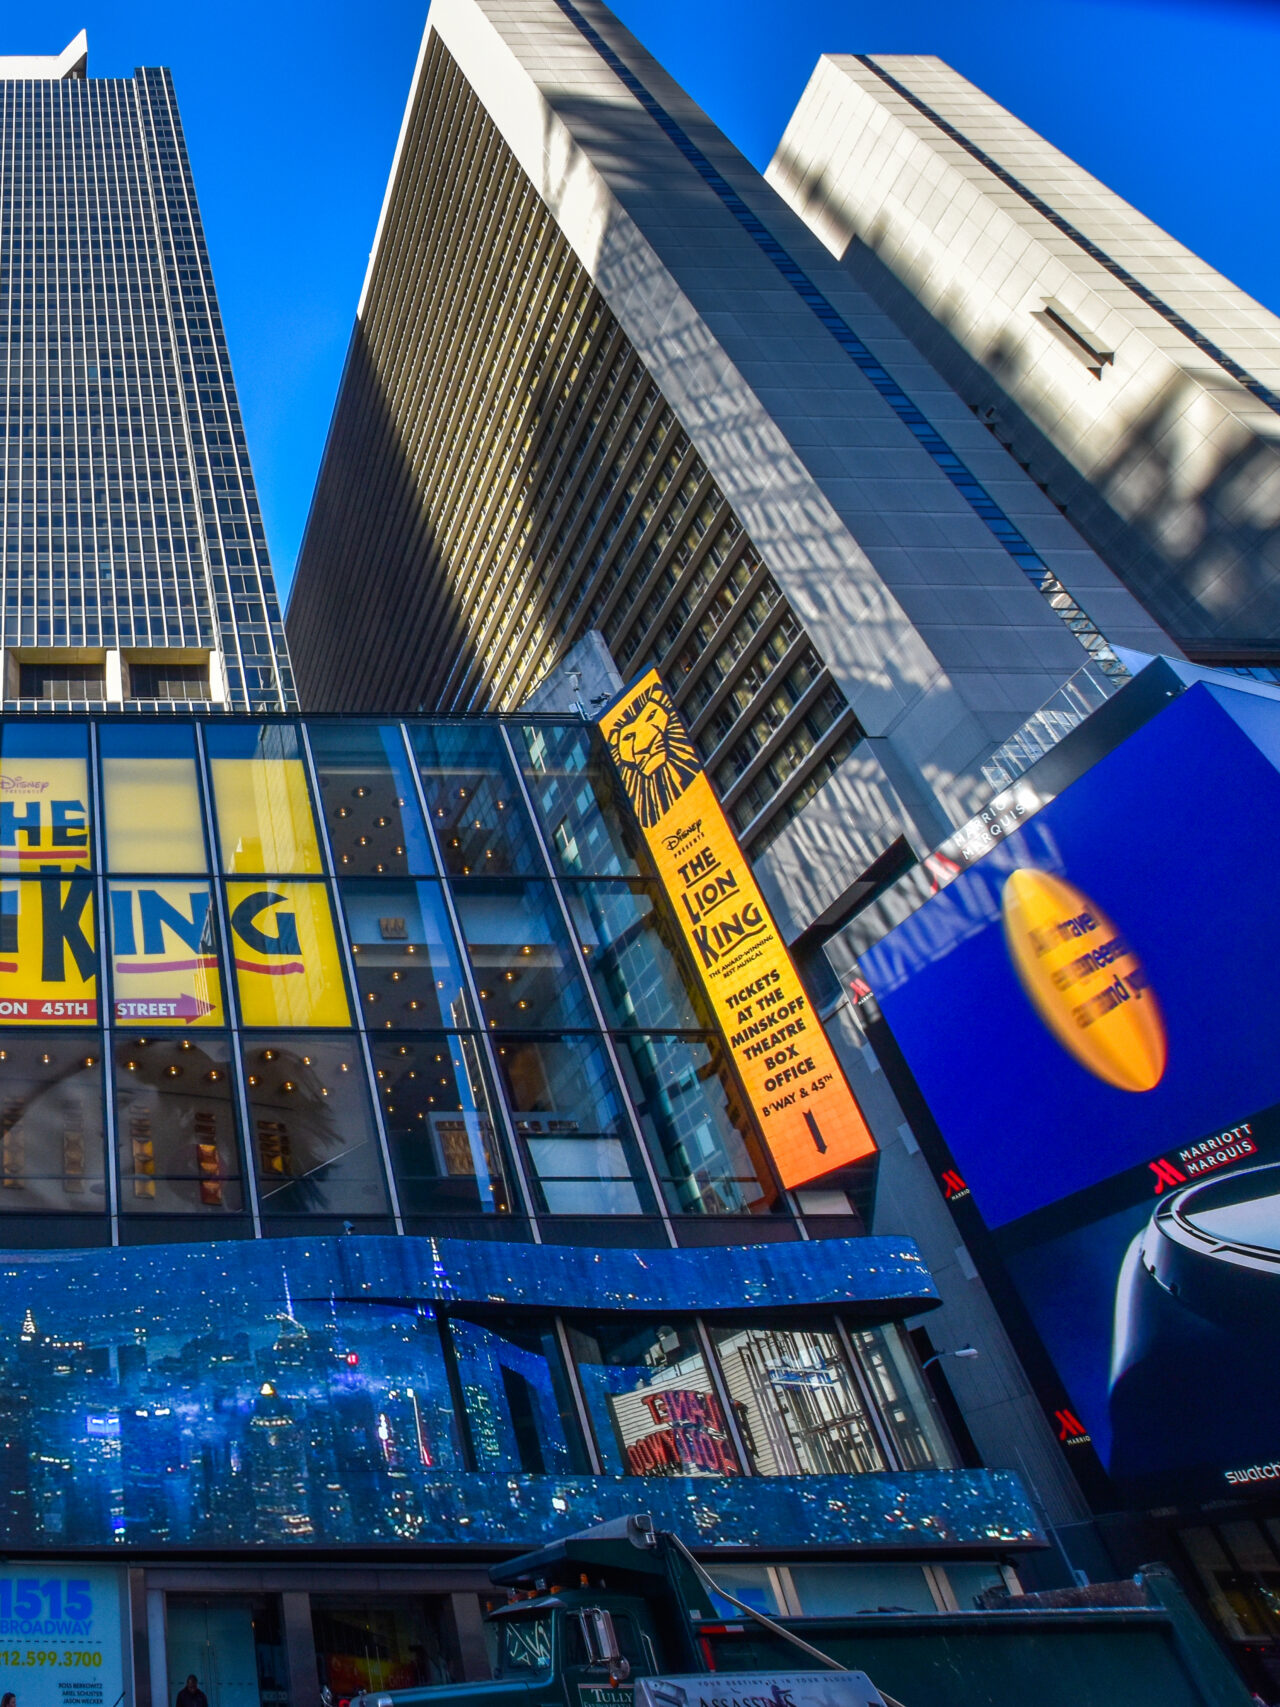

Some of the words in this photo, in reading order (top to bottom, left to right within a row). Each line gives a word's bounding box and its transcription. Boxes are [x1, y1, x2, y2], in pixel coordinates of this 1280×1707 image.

[678, 846, 716, 884] THE
[681, 868, 738, 925] LION
[39, 864, 302, 983] KING
[691, 902, 763, 969] KING
[709, 969, 721, 979] THE
[721, 934, 774, 971] AWARD-WINNING
[723, 967, 738, 979] BEST
[737, 951, 763, 971] MUSICAL
[725, 969, 781, 1009] TICKETS
[737, 1006, 753, 1025] AT
[756, 987, 785, 1012] THE
[41, 1002, 88, 1016] 45TH
[117, 1003, 177, 1016] STREET
[730, 996, 805, 1049] MINSKOFF
[742, 1017, 807, 1061] THEATRE
[764, 1043, 800, 1072] BOX
[764, 1057, 816, 1092] OFFICE
[761, 1092, 796, 1117] B'WAY
[799, 1087, 810, 1099] &
[811, 1073, 834, 1092] 45TH
[1179, 1123, 1253, 1161] MARRIOTT
[1186, 1140, 1253, 1174] MARQUIS
[1225, 1461, 1280, 1484] swatch
[0, 1620, 94, 1636] BROADWAY
[591, 1688, 632, 1703] TULLY
